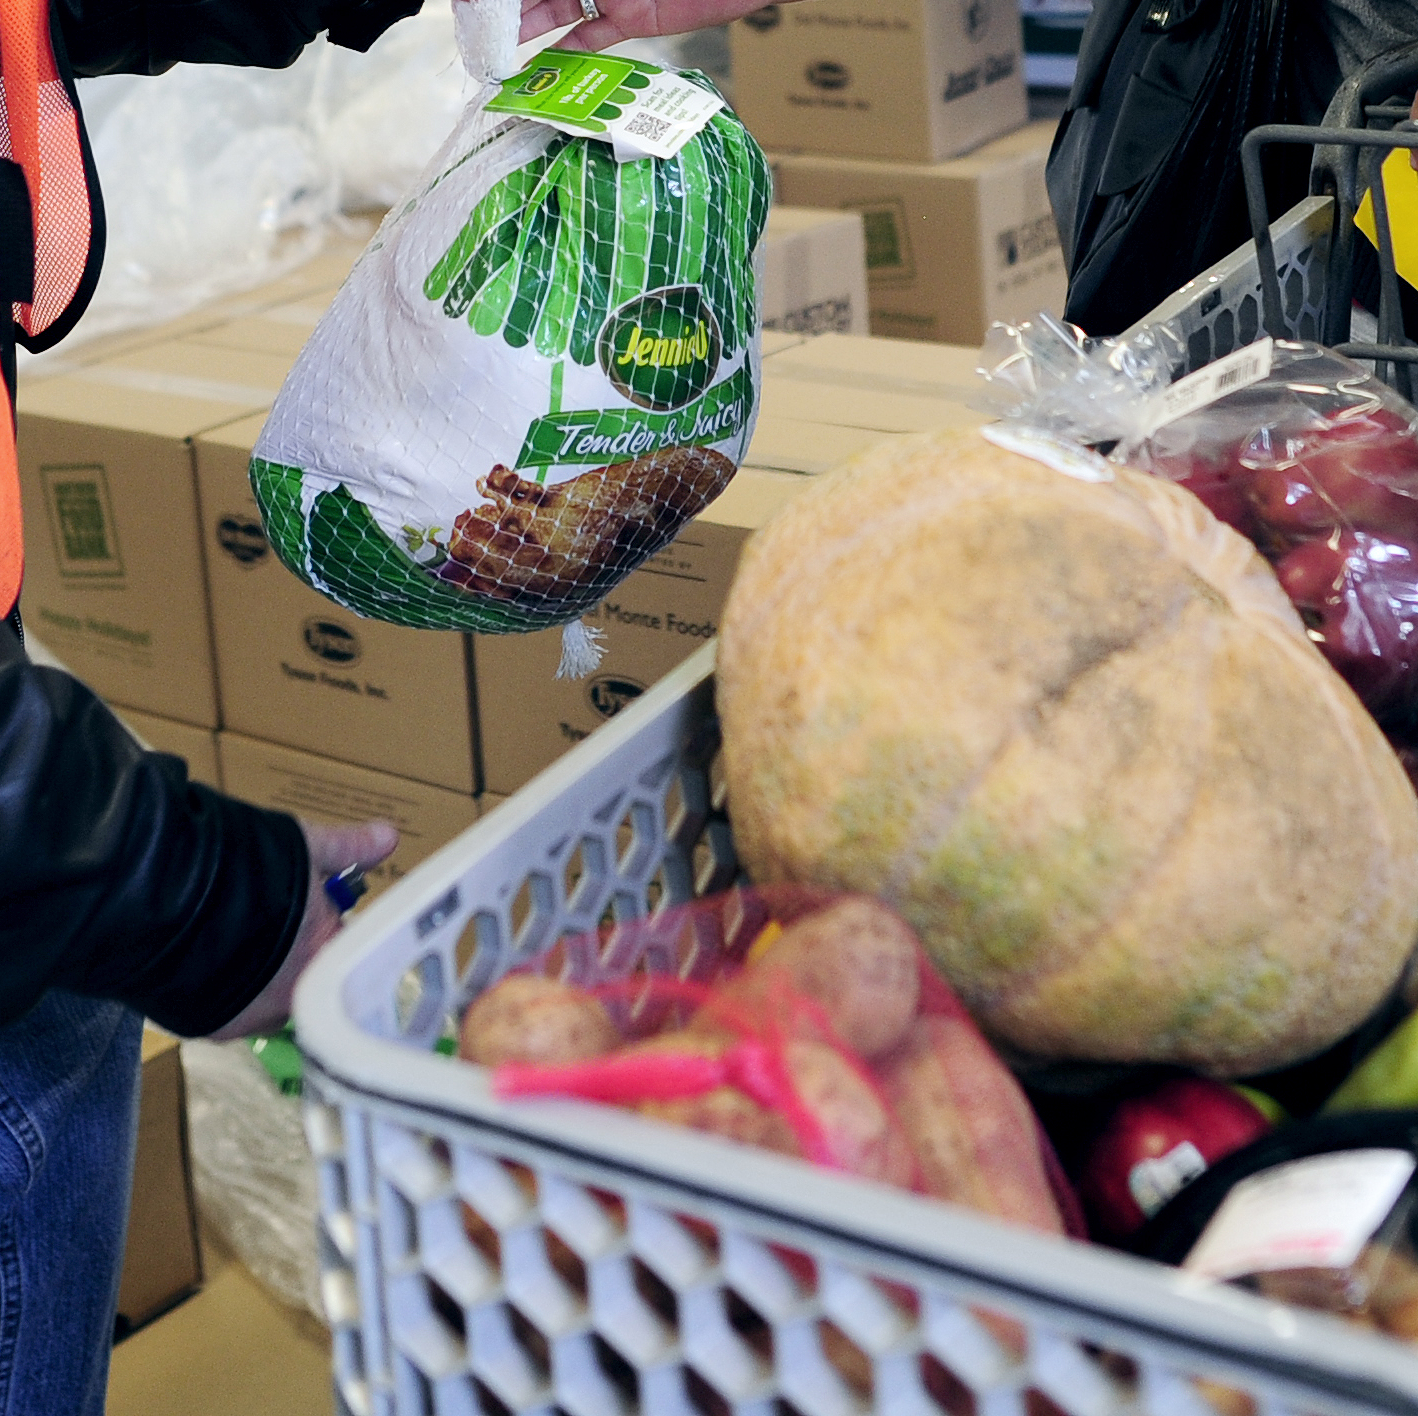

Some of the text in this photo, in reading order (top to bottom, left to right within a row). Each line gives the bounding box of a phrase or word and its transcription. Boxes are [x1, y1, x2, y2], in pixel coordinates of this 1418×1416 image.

[574, 73, 609, 105] per person
[576, 68, 602, 88] turkey
[673, 88, 697, 109] cooking
[556, 397, 743, 456] Tender & Juicy
[605, 603, 661, 630] Monte
